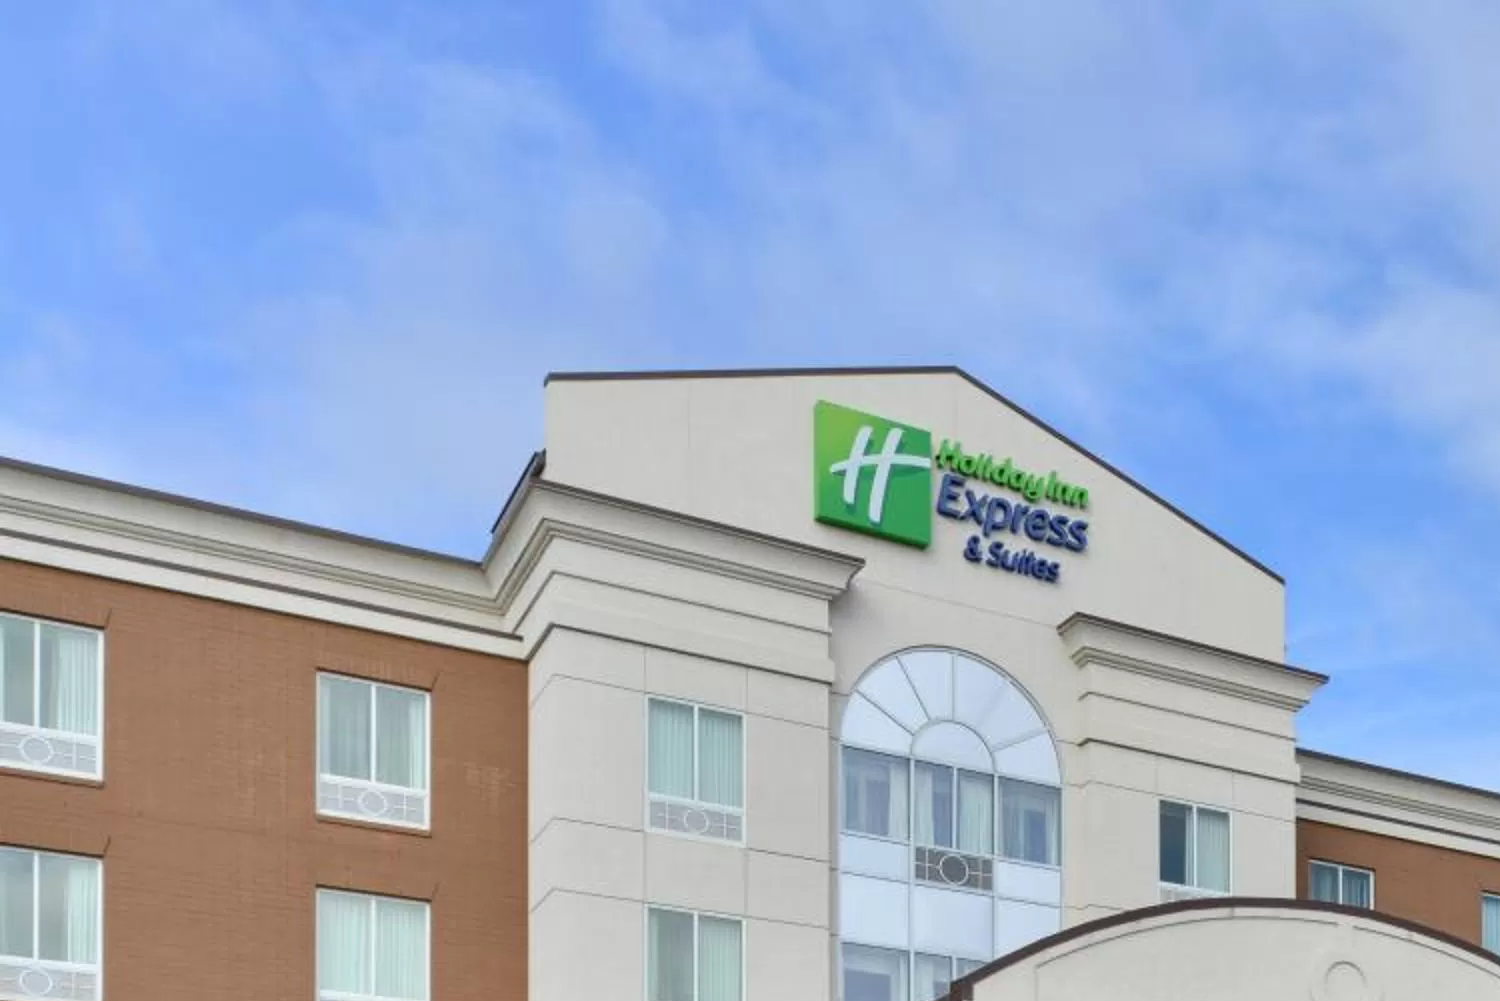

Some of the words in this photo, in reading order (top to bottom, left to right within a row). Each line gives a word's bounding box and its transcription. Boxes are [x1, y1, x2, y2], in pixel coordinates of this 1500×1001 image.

[935, 438, 1044, 501] Holiday
[1046, 470, 1090, 508] Inn
[936, 473, 1089, 551] Express
[963, 535, 982, 563] &
[986, 540, 1061, 583] Suites
